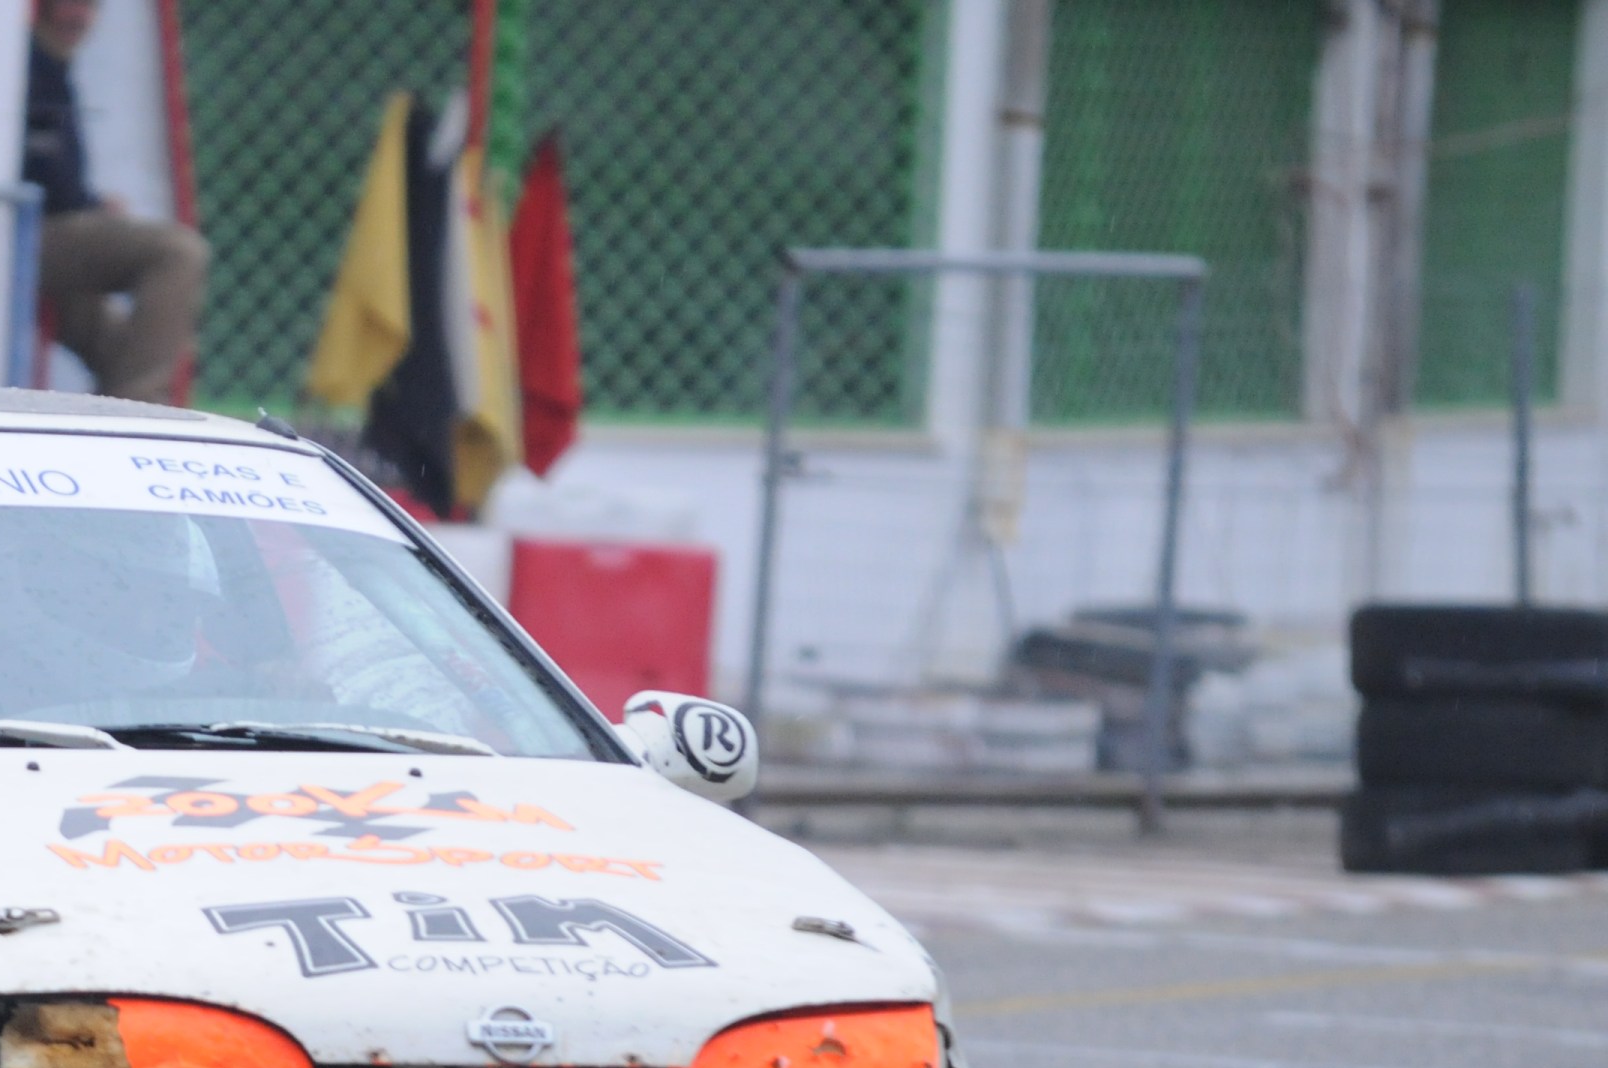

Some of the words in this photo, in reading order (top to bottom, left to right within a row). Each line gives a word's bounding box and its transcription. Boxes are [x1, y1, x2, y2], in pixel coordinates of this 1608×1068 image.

[130, 456, 261, 481] PEÇAS
[279, 472, 306, 488] E
[148, 484, 328, 515] CAMIÕES
[387, 954, 651, 981] COMPETIÇÃO
[480, 1023, 547, 1039] NISSAN
